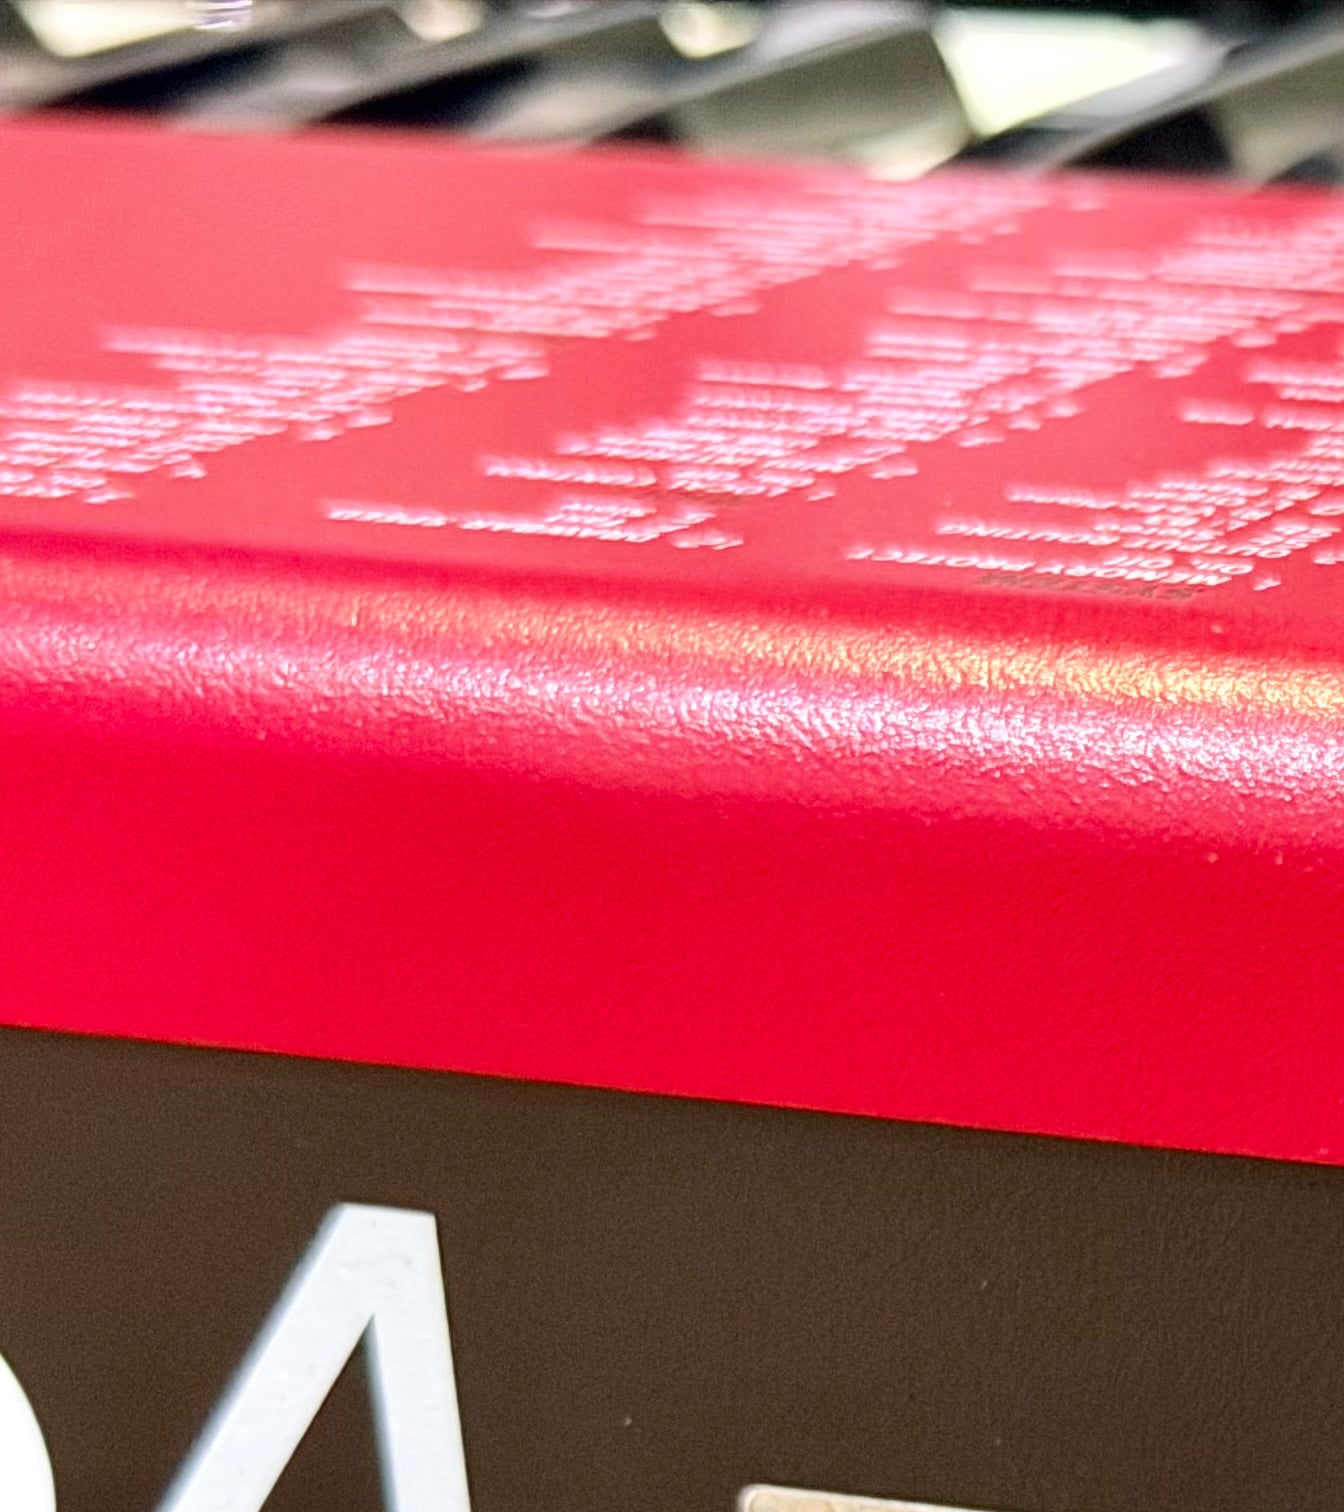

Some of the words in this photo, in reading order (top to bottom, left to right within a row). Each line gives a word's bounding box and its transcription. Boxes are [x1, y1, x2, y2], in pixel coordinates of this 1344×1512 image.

[936, 523, 1121, 547] ROUTING
[844, 546, 1036, 573] PROTECT
[1036, 560, 1232, 586] MEMORY
